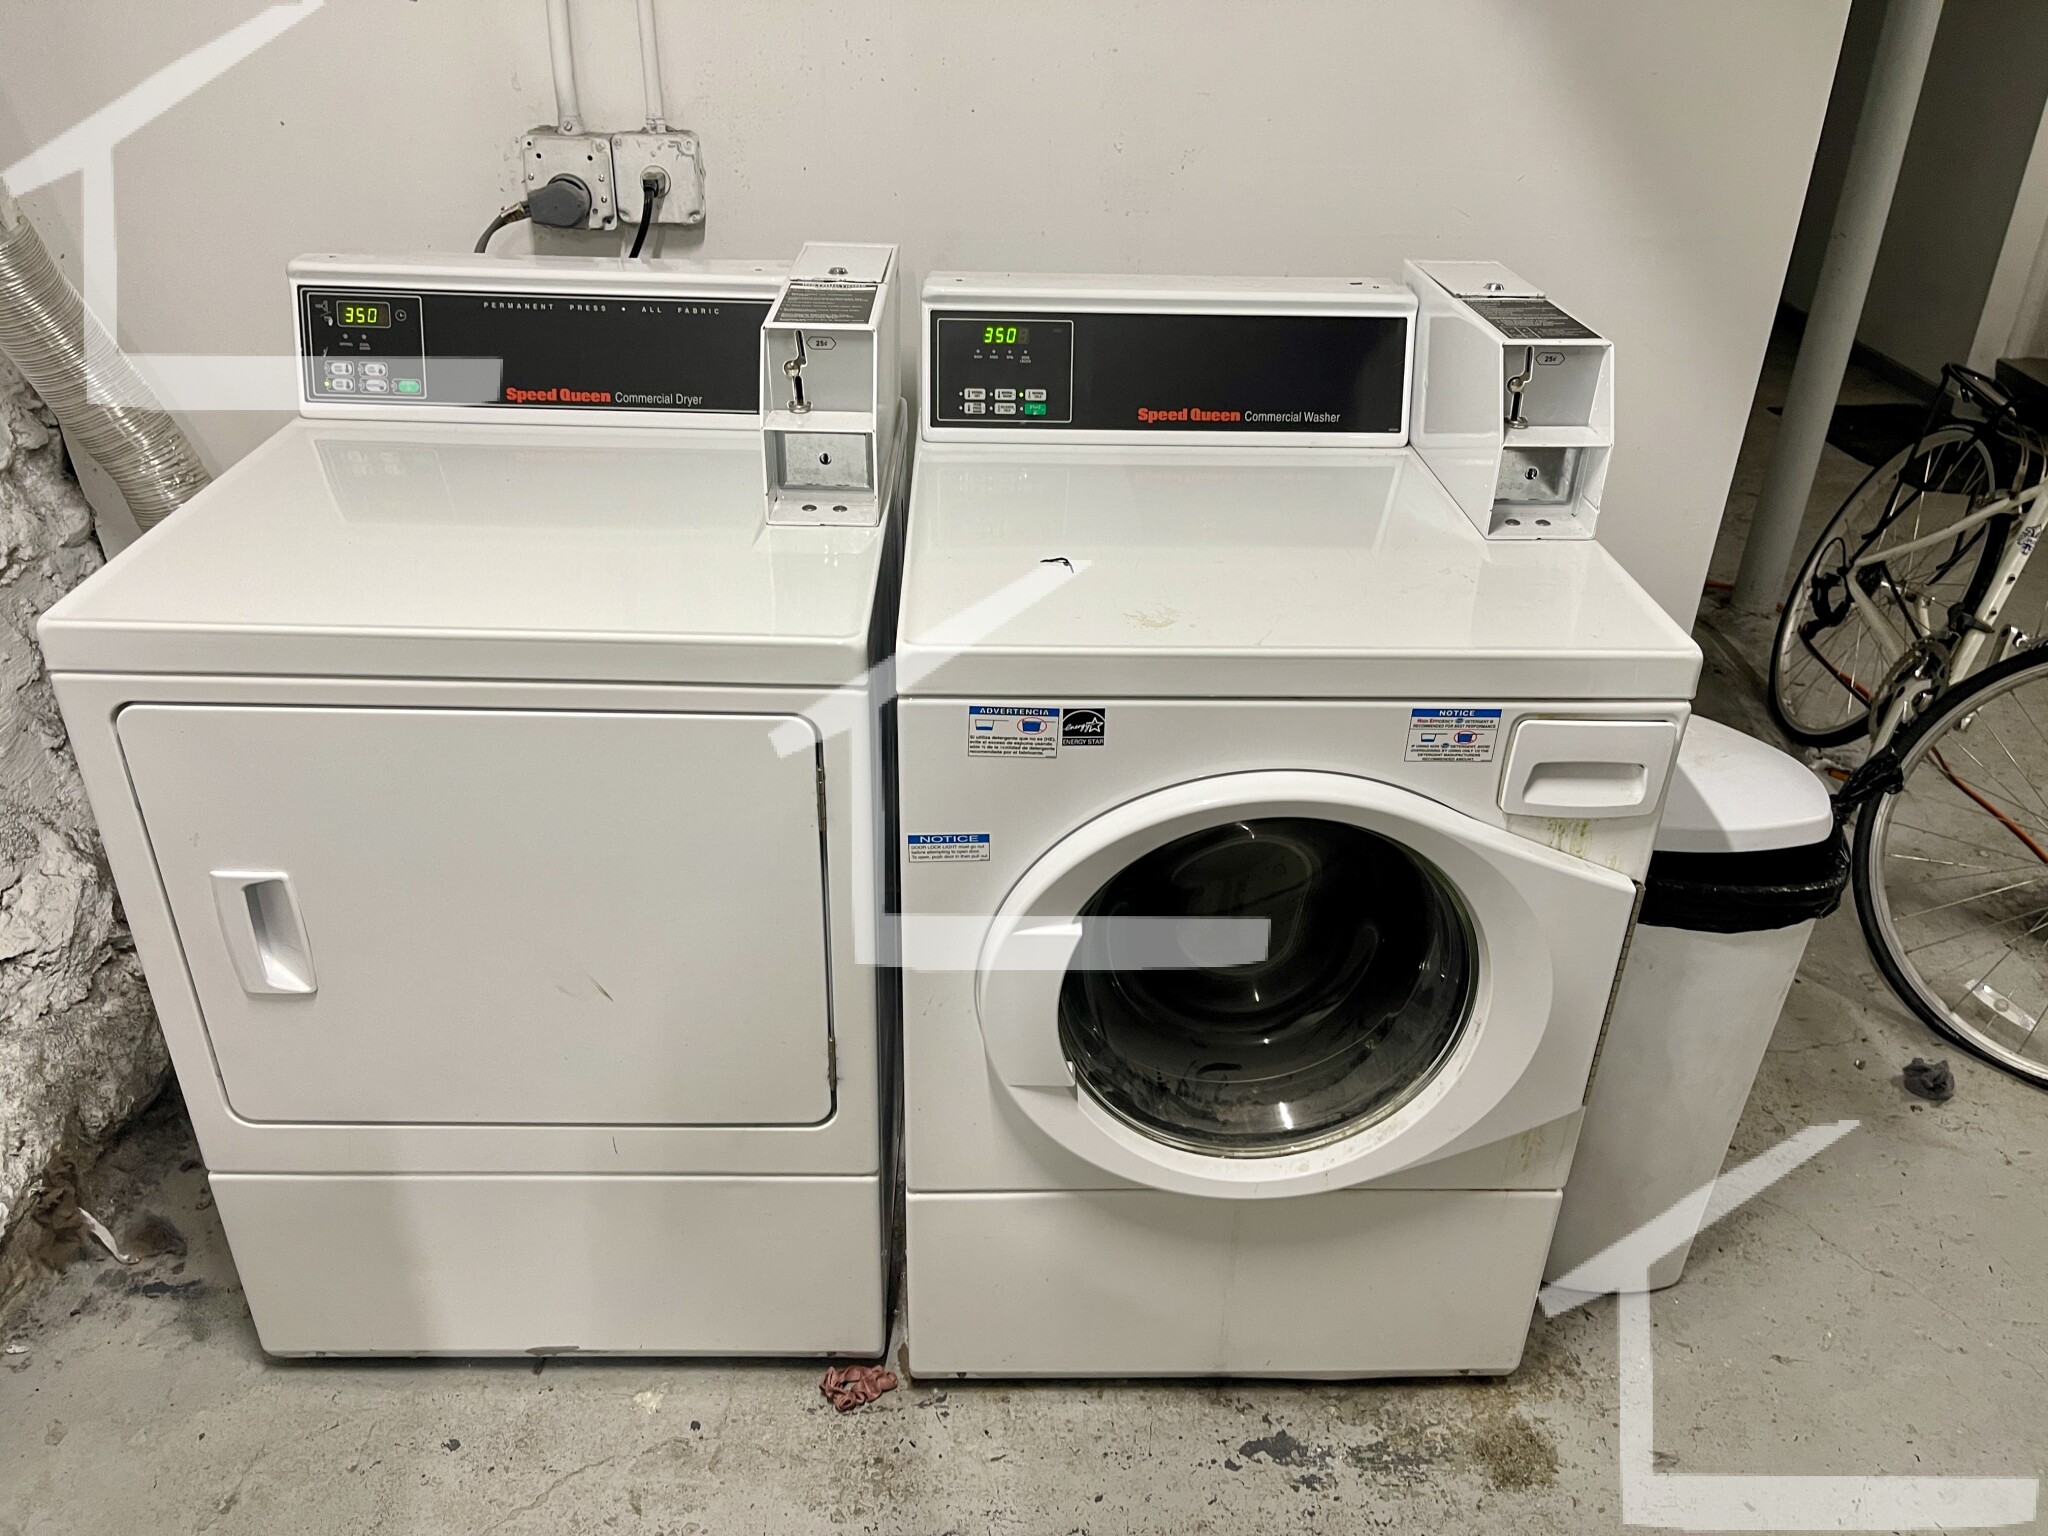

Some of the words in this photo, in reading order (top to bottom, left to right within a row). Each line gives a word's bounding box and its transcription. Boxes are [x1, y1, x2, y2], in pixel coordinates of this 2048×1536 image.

[345, 308, 378, 323] 350
[483, 302, 554, 311] PERMANENT
[569, 304, 607, 312] PRESS
[642, 306, 662, 314] ALL
[678, 307, 720, 315] FABRIC
[984, 327, 1017, 344] 350
[506, 387, 557, 403] Speed
[560, 388, 611, 403] Queen
[614, 391, 673, 404] Commercial
[676, 393, 703, 407] Dryer
[1137, 407, 1188, 423] Speed
[1190, 408, 1241, 422] Queen
[1244, 410, 1302, 423] Commercial
[1304, 411, 1341, 423] Washer
[980, 708, 1049, 716] ADVERTENCIA
[920, 835, 979, 843] NOTICE
